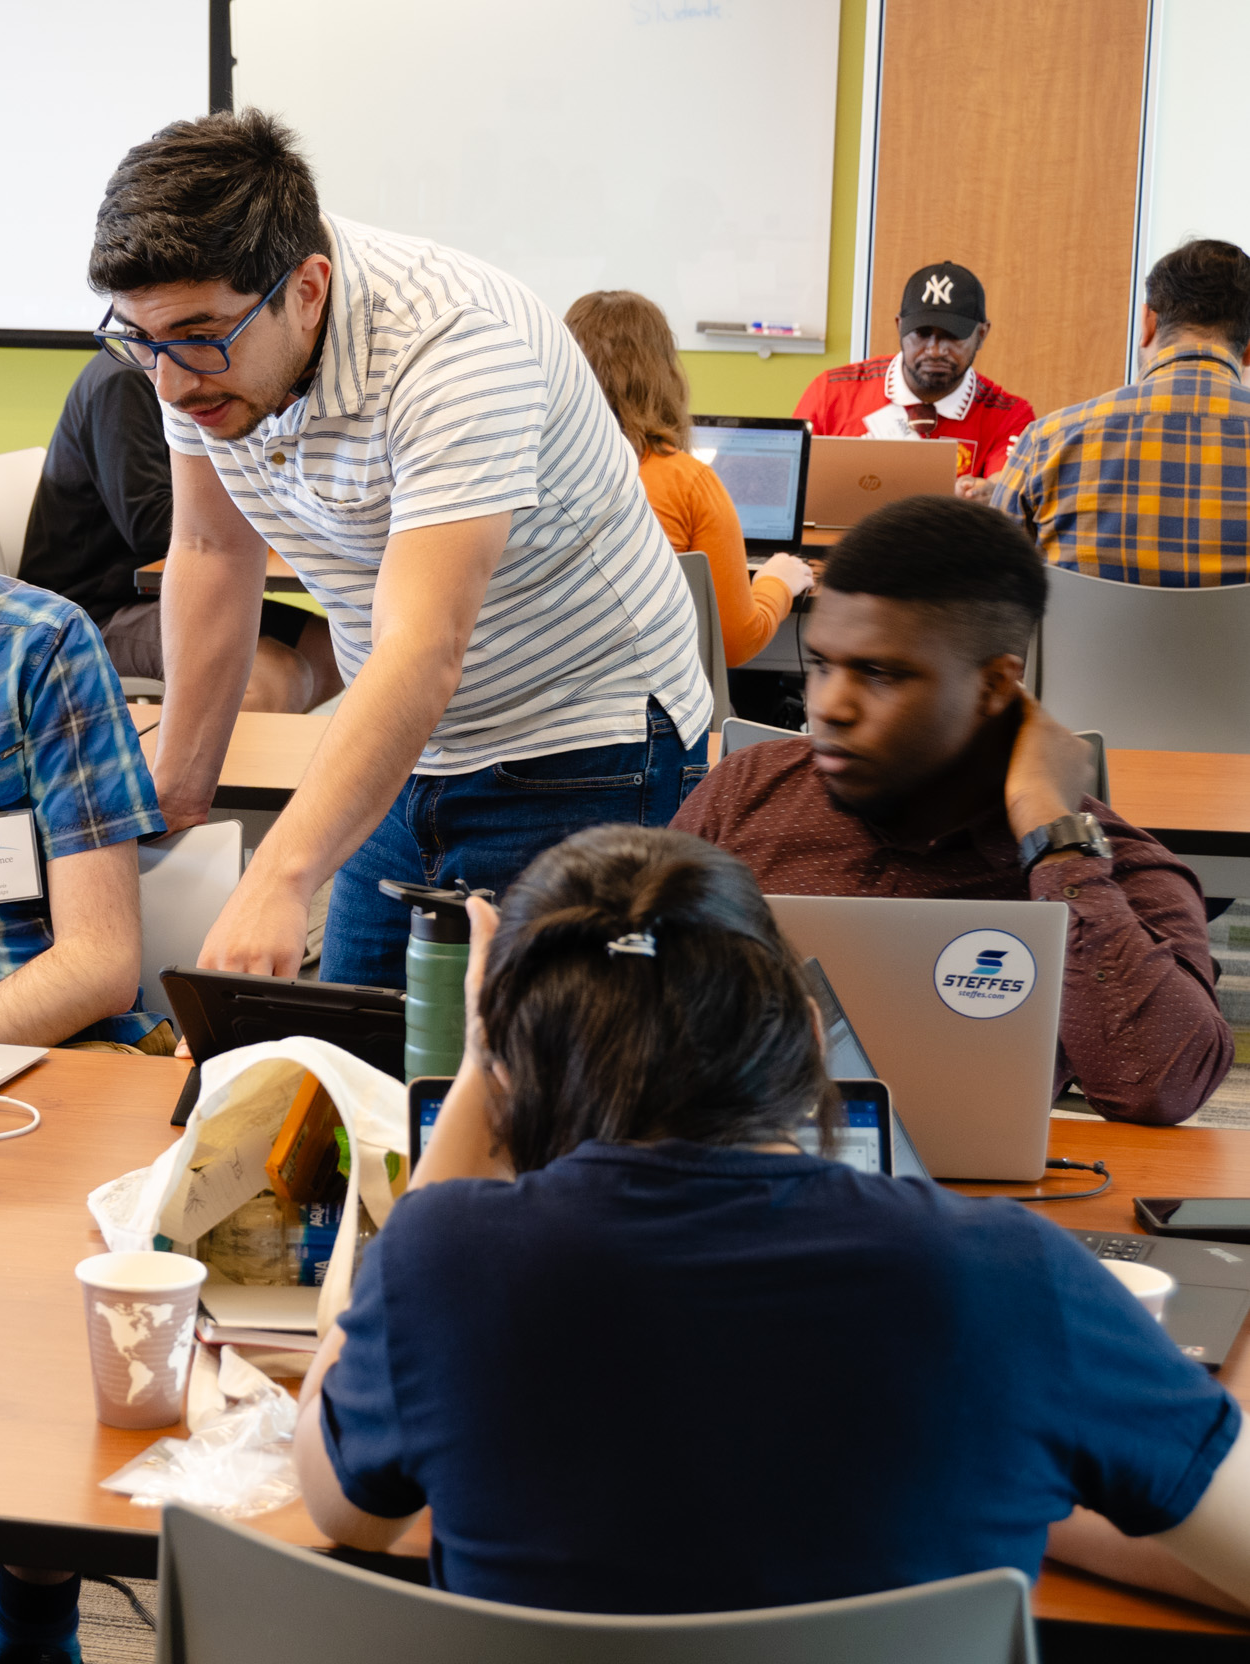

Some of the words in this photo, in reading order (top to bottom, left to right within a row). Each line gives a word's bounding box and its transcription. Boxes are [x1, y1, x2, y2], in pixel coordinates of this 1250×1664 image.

[921, 274, 954, 305] NY
[859, 474, 882, 491] hp
[942, 974, 1024, 992] STEFFES
[958, 990, 1005, 1000] steffes.com
